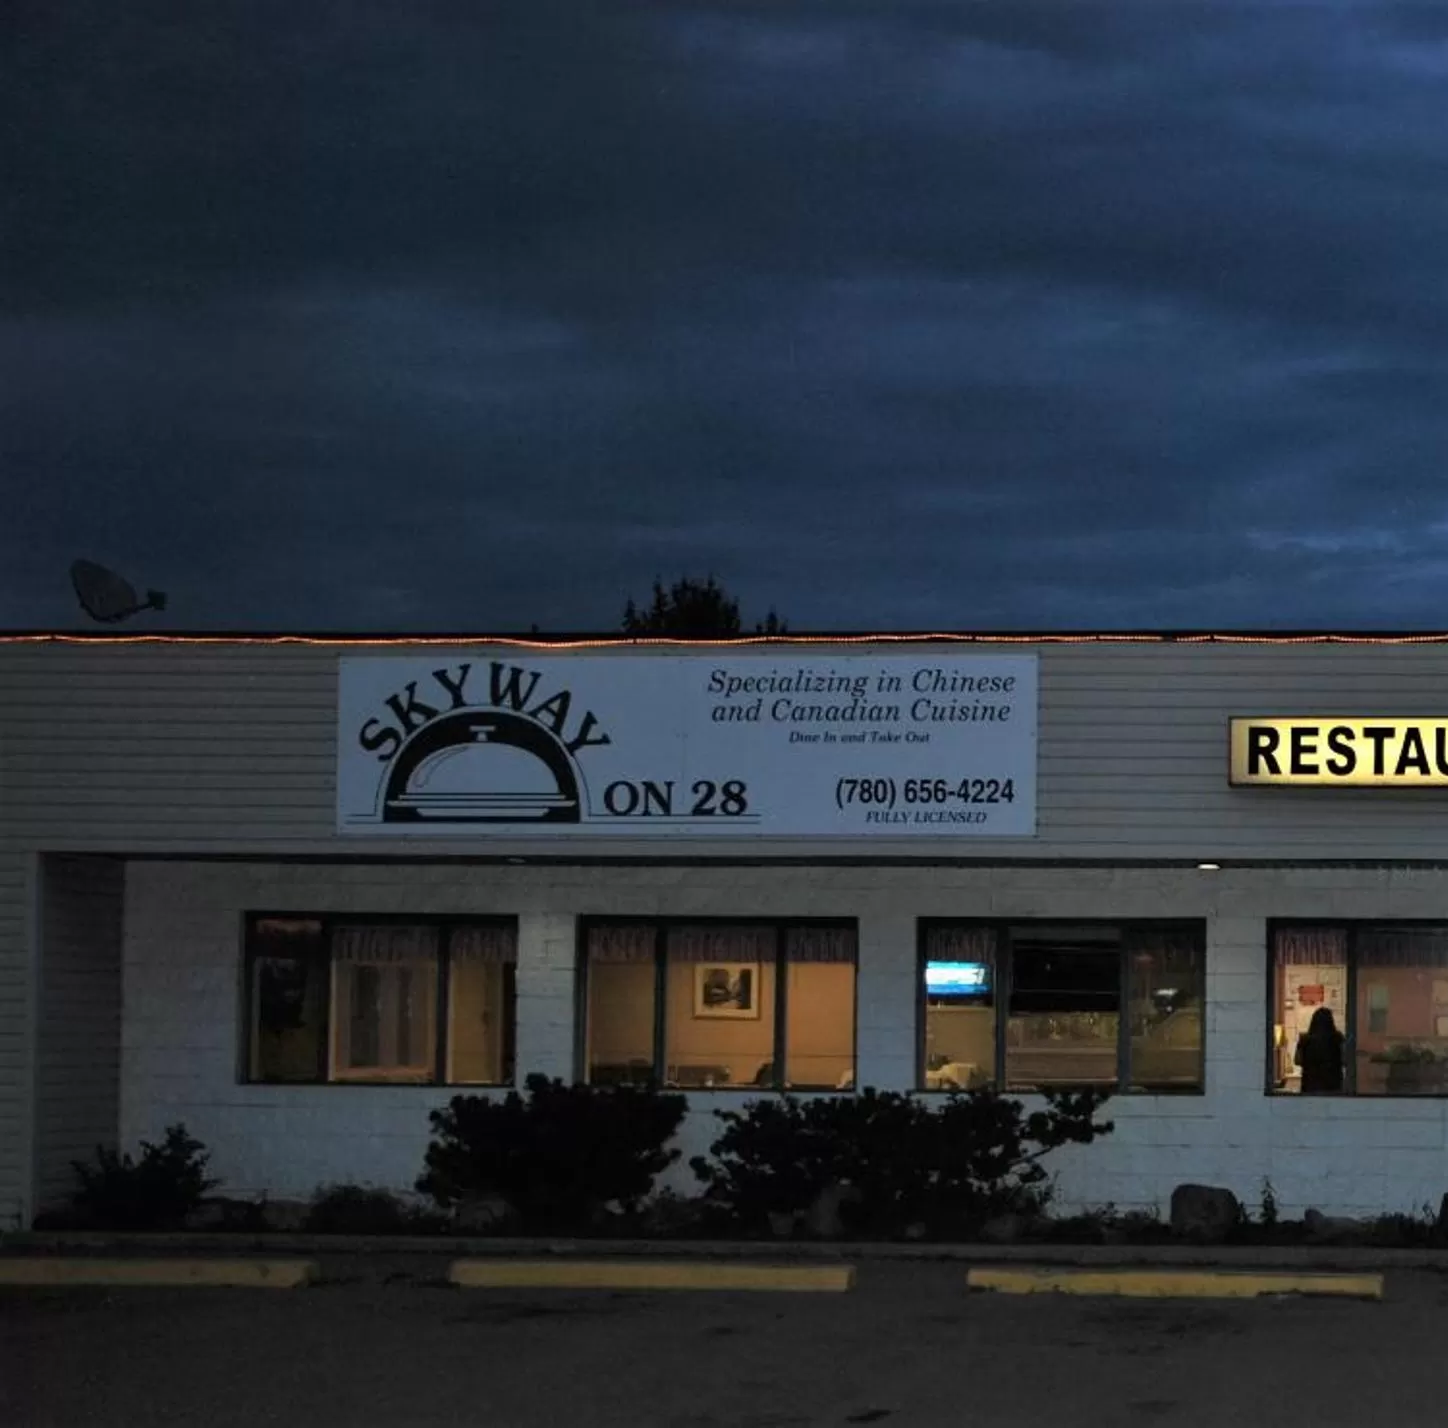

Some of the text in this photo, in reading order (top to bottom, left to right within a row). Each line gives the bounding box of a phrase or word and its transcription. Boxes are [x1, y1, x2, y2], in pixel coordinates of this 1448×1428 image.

[707, 669, 1017, 698] Specializing in Chinese
[359, 662, 611, 762] SKYWAY
[711, 699, 1012, 723] and Canadian Cuisine
[789, 731, 931, 744] Dine In and Take Out
[603, 780, 748, 817] ON 28
[836, 777, 1015, 810] (780) 656-4224
[865, 811, 988, 824] FULLY LICENSED
